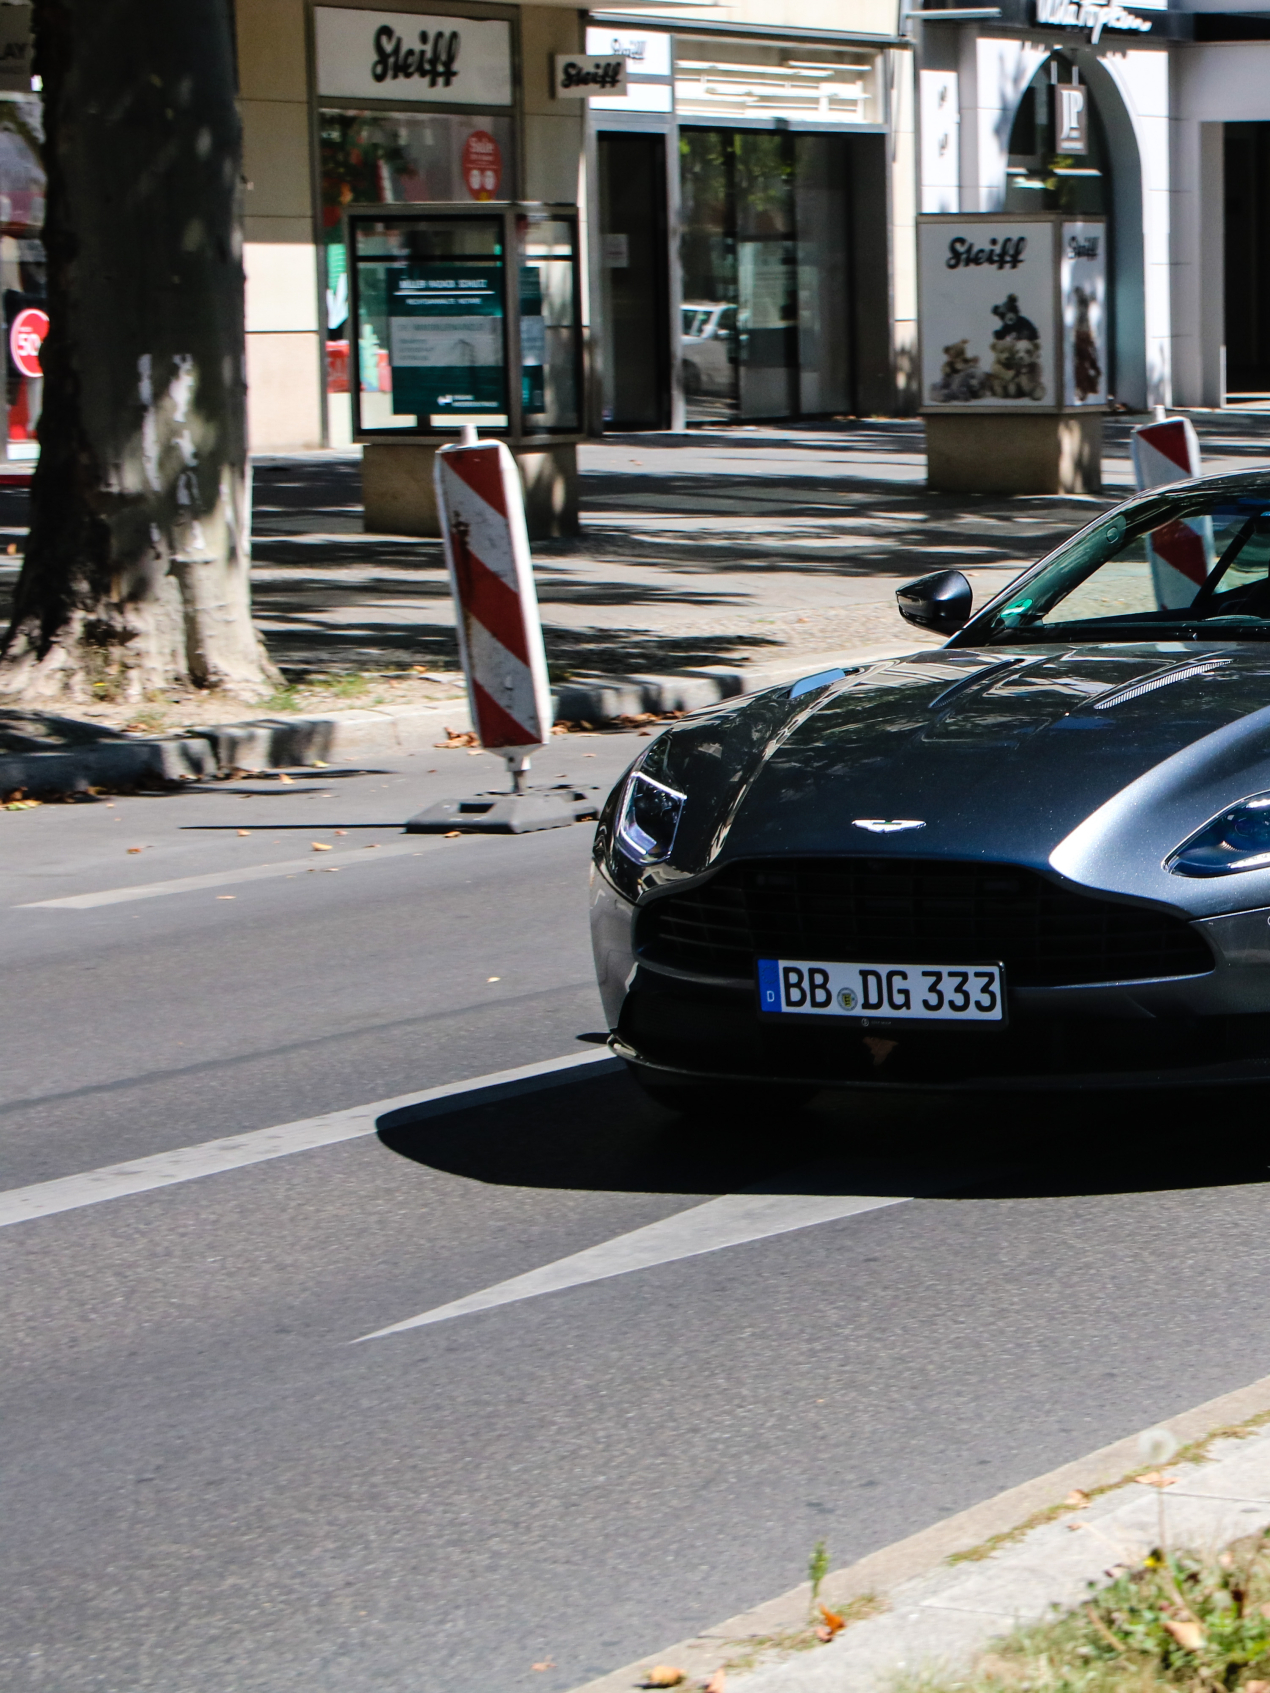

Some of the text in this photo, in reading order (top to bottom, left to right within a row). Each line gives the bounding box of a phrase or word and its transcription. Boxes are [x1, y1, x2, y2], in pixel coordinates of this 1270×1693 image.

[371, 25, 461, 88] Steiff
[561, 62, 622, 89] Steiff
[945, 236, 1028, 270] Steiff
[782, 966, 998, 1013] BB DG 333
